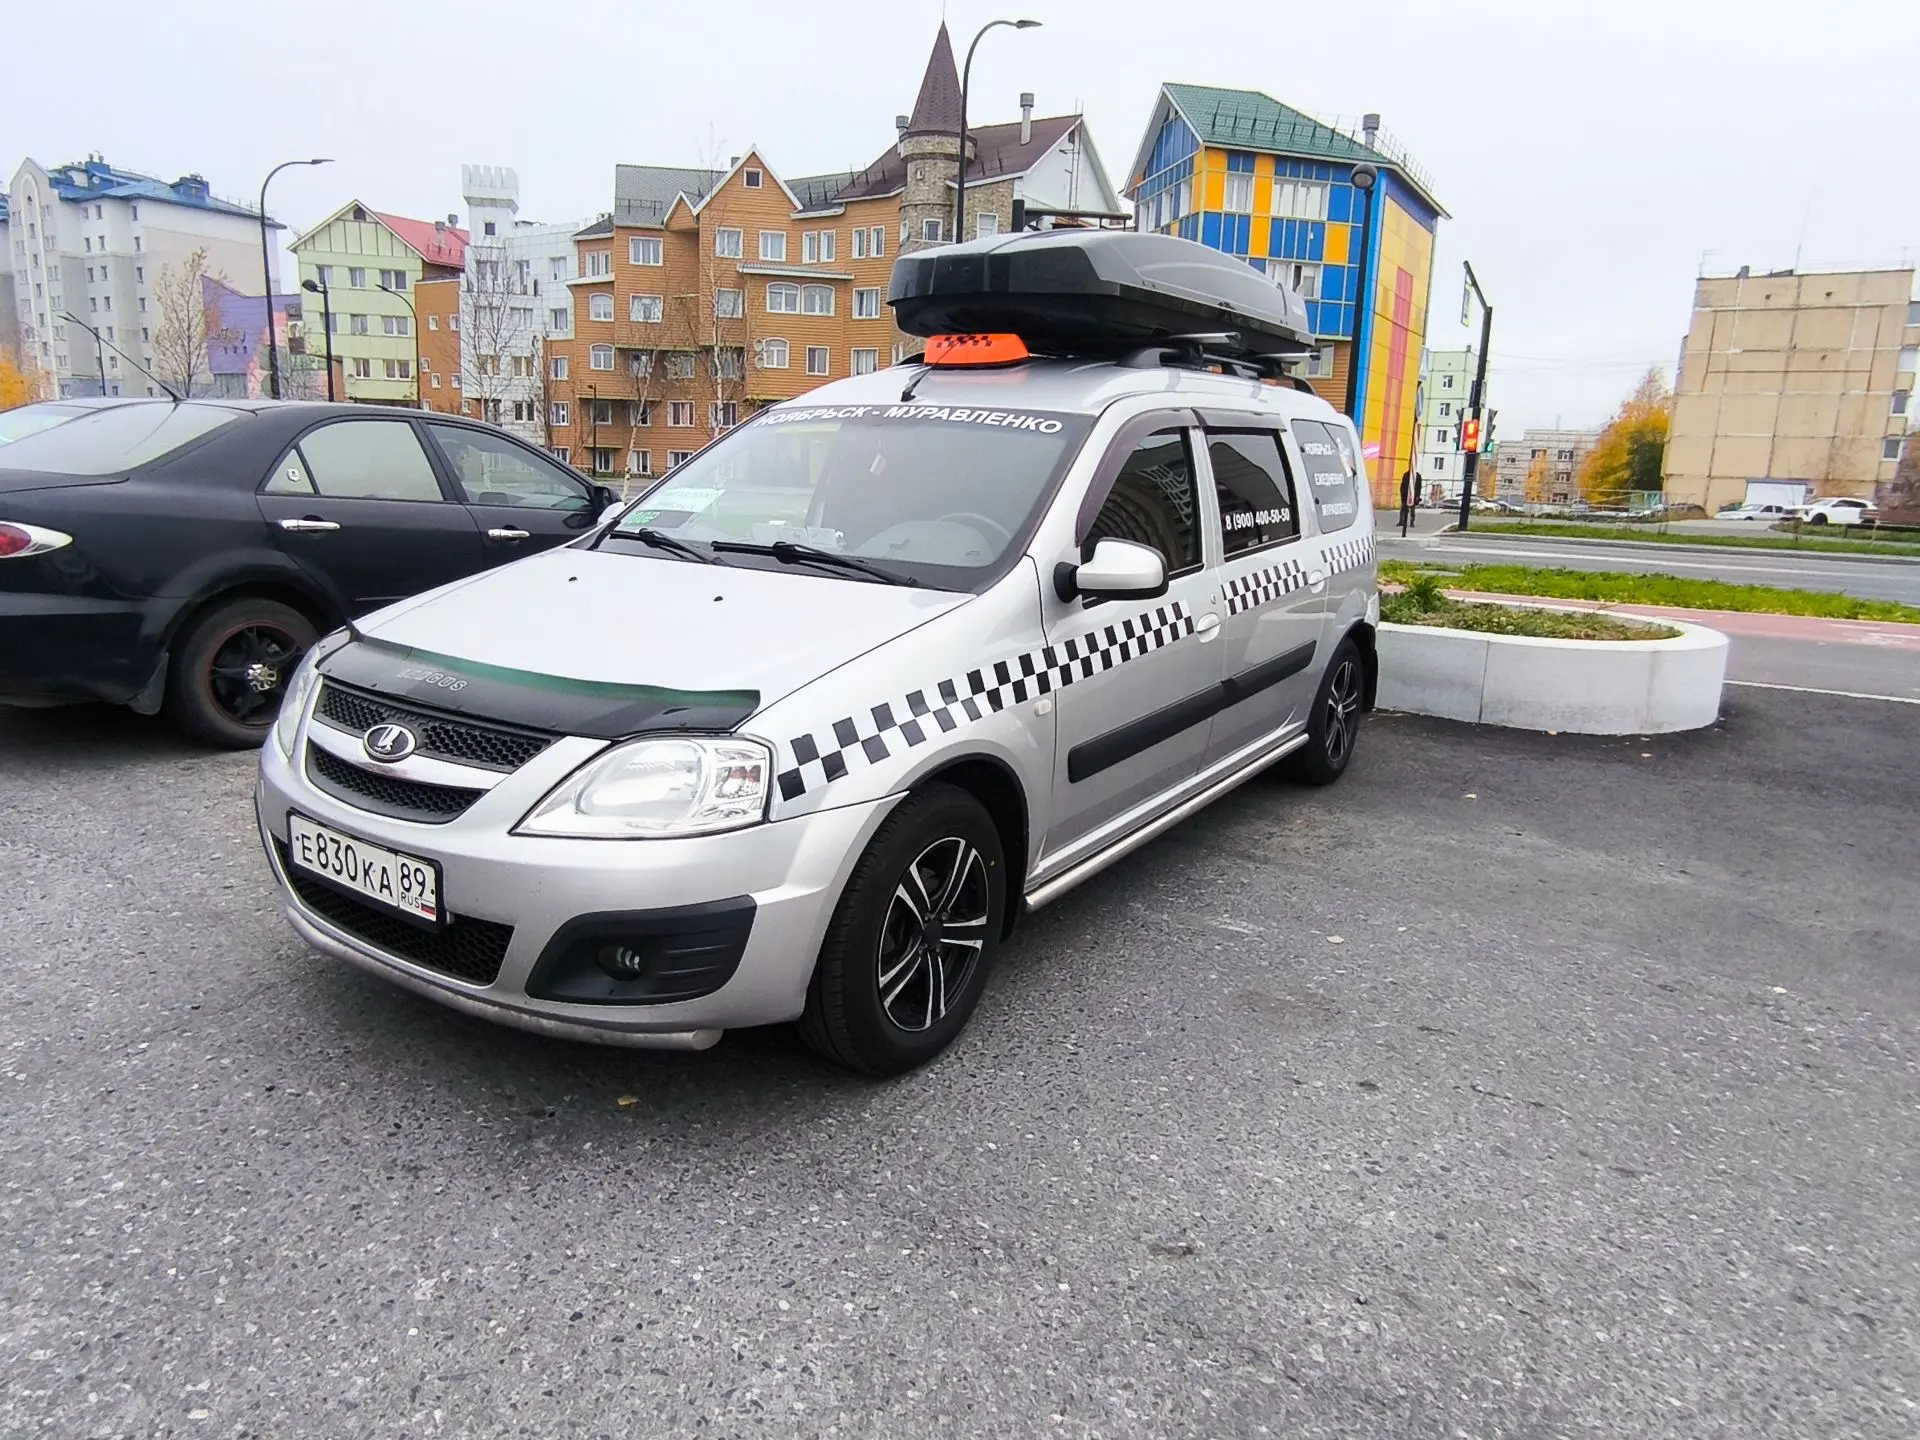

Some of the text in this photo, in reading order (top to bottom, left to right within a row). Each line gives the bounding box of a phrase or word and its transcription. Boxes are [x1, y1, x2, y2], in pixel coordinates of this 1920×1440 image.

[754, 406, 873, 428] НОЯБРЬСК
[883, 406, 1064, 434] МУРАВЛЕНКО
[1225, 507, 1291, 531] 8 (900) 400-50-50
[301, 831, 426, 898] Е830КА 89
[400, 893, 421, 908] RUS
